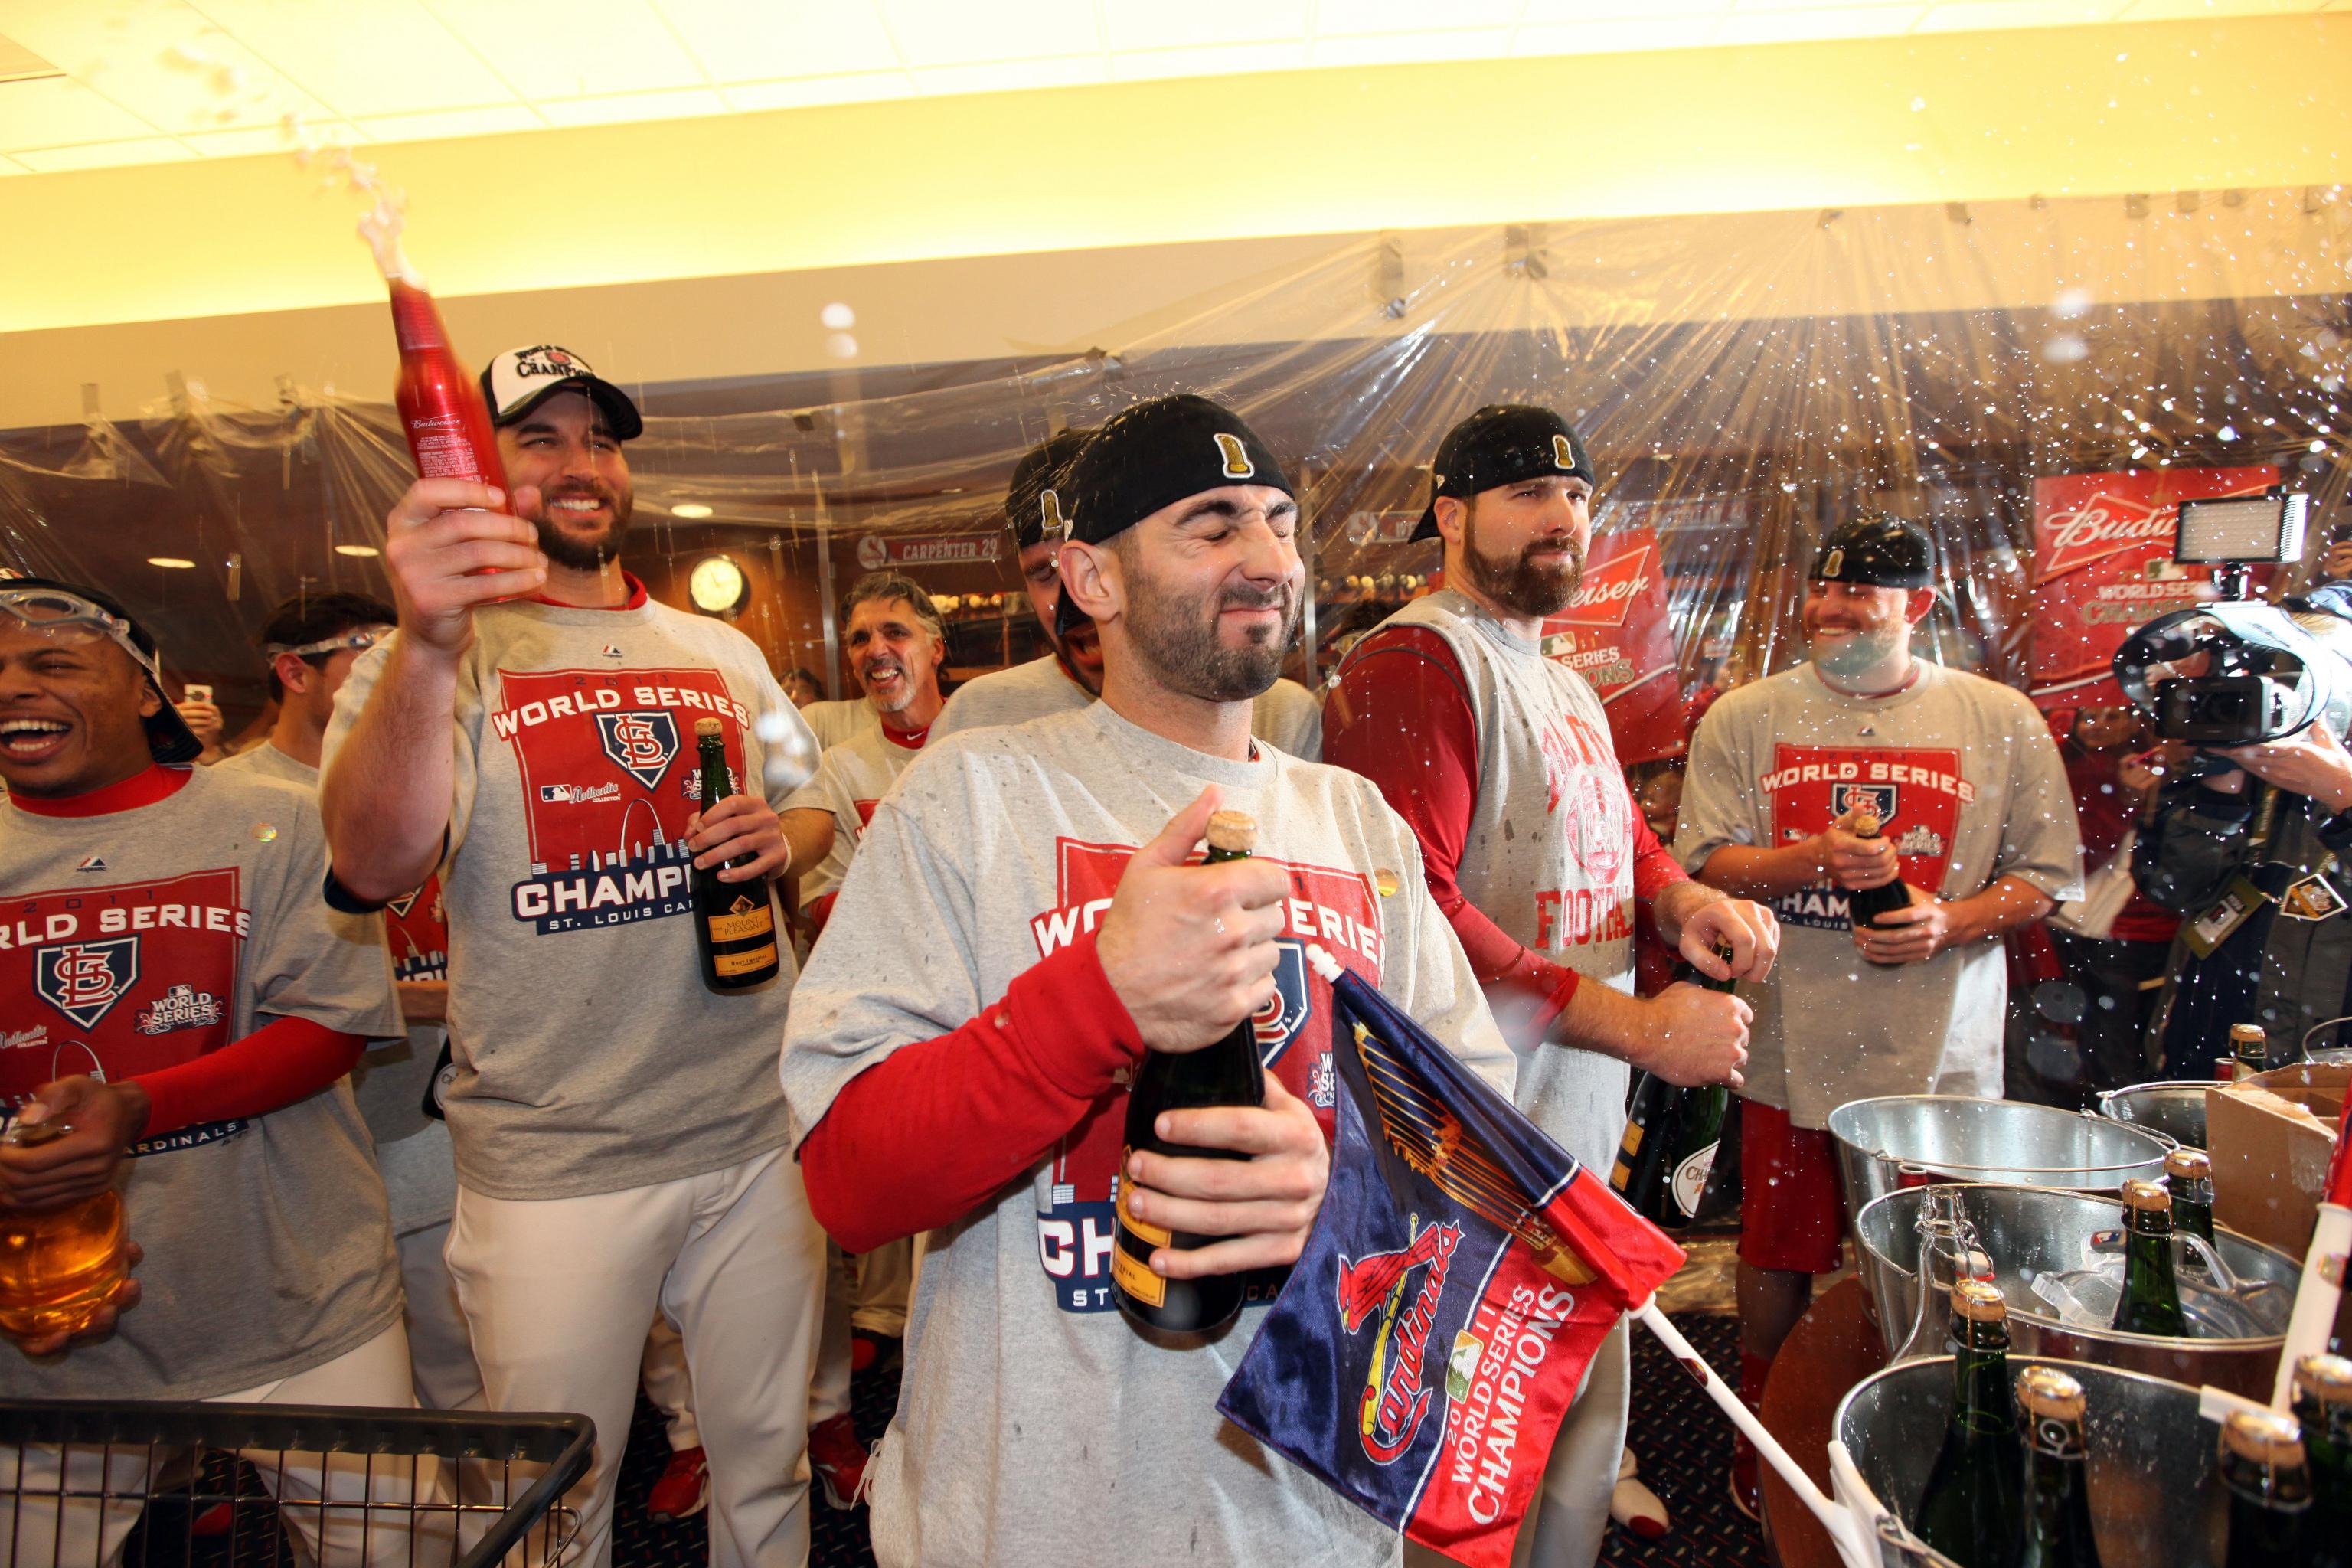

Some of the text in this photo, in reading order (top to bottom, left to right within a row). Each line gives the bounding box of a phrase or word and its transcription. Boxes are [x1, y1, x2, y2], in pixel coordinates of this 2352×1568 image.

[411, 419, 461, 429] Budweiser
[903, 541, 976, 560] CARPENTER
[982, 538, 998, 557] 29
[2097, 583, 2164, 601] WORLD
[1561, 646, 1620, 668] SERIES
[1582, 658, 1635, 688] ONS
[493, 687, 750, 738] WORLD SERIES
[569, 781, 619, 803] Authentic
[1762, 763, 1975, 803] WORLD SERIES
[24, 890, 153, 913] 2011
[100, 904, 252, 936] SERIES
[549, 918, 581, 930] ST.
[595, 907, 652, 924] LOUIS
[724, 920, 763, 936] PLEASANT
[726, 916, 759, 929] MOUNT
[1804, 918, 1848, 930] LOUIS
[152, 992, 212, 1012] WORLD
[152, 1004, 212, 1024] SERIES
[123, 1122, 238, 1155] ARDINALS
[1359, 1220, 1466, 1465] Cardinals
[1452, 1285, 1535, 1484] WORLD SERIES
[1468, 1282, 1575, 1525] CHAMPIONS
